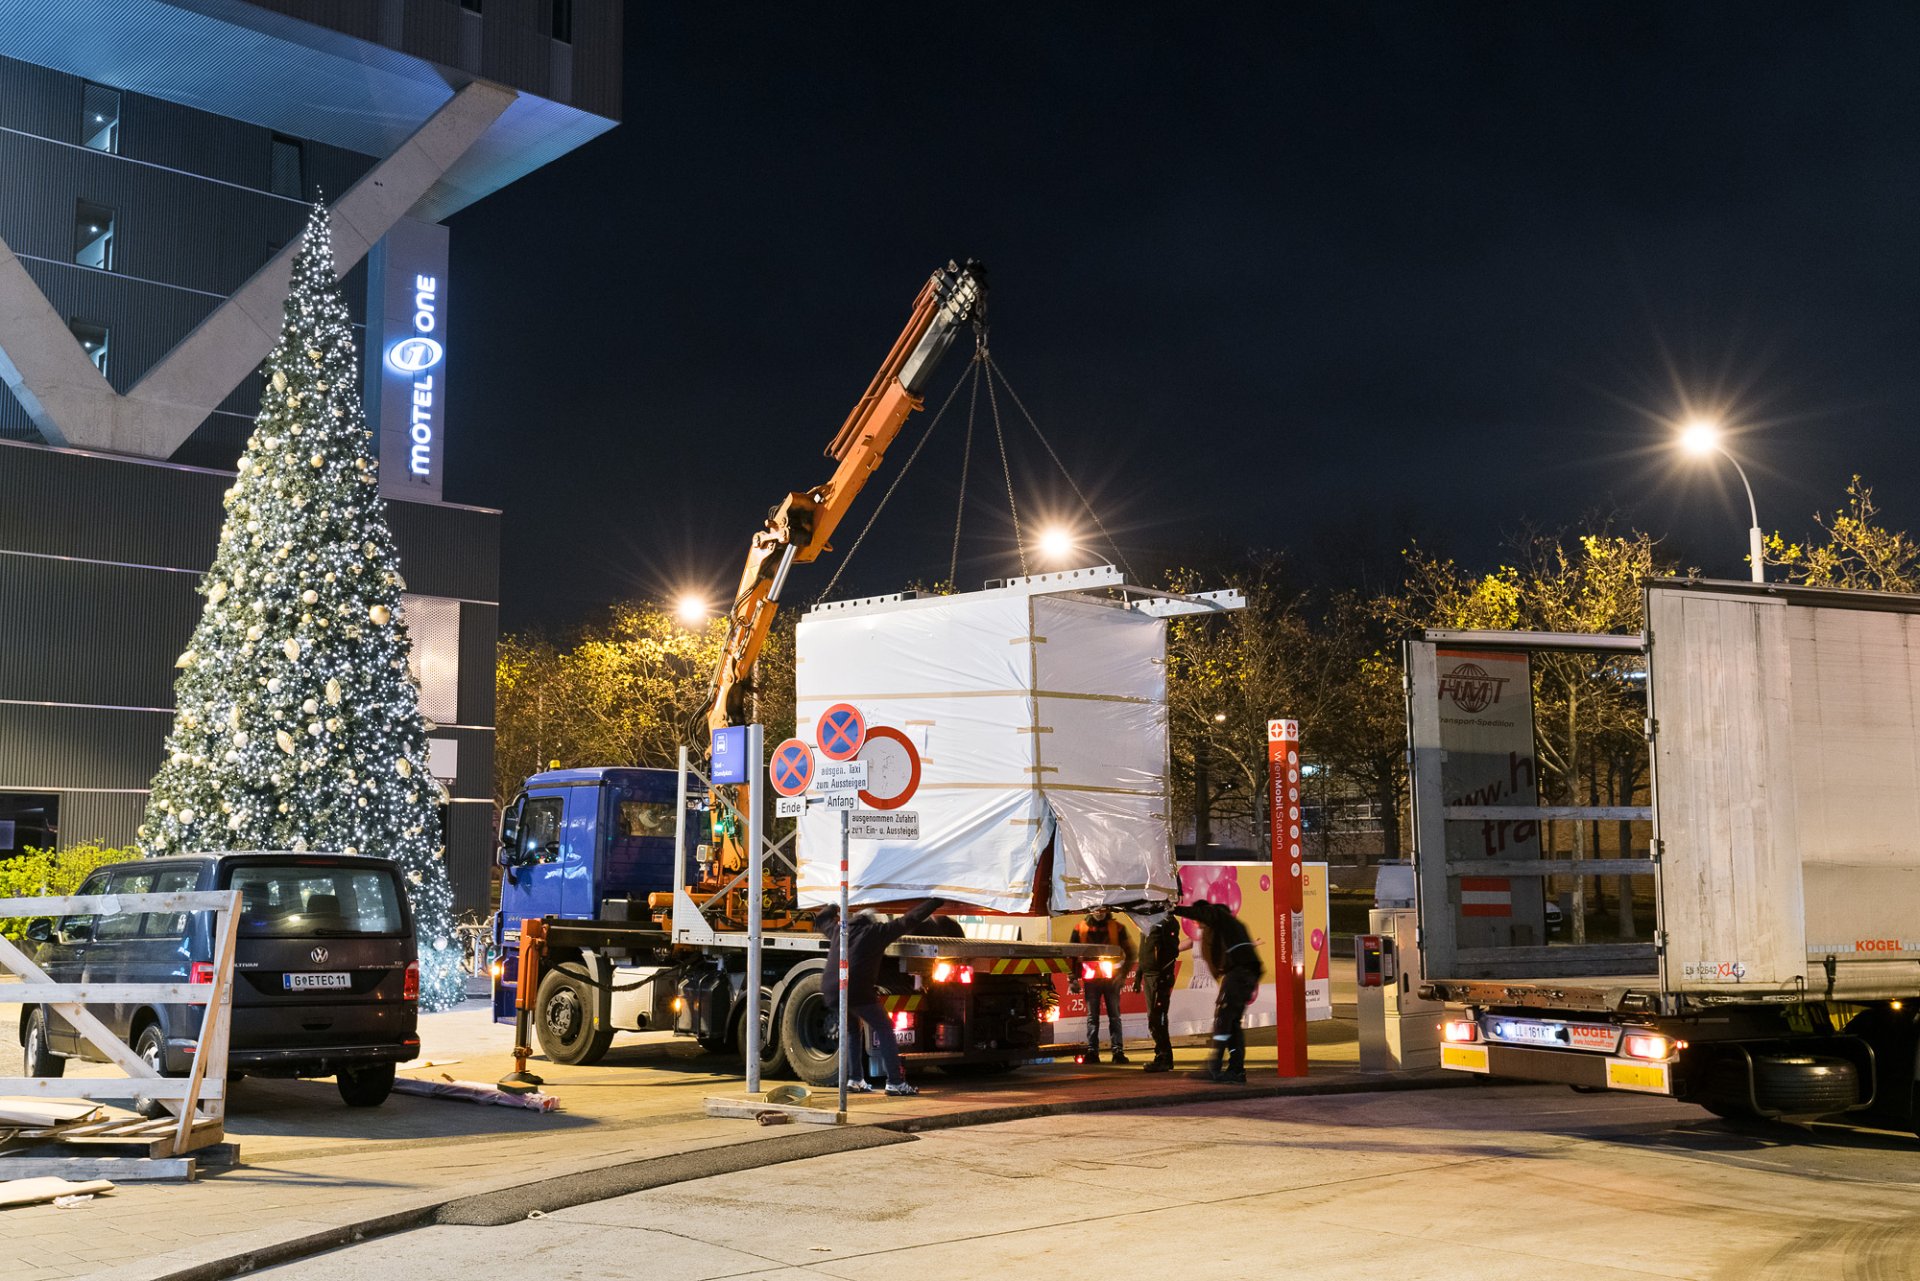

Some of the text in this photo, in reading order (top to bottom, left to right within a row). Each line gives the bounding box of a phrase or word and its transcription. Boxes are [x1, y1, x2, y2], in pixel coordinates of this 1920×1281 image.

[416, 274, 435, 332] ONE
[411, 375, 432, 475] MOTEL
[1438, 673, 1510, 704] HMT
[1440, 716, 1515, 728] ransport-Spedition
[849, 764, 861, 774] Taxi
[816, 778, 866, 792] zum Aussteigen
[781, 802, 801, 813] Ende
[827, 795, 854, 809] Anfang
[852, 813, 917, 825] ausgenommen Zufahrt
[887, 826, 917, 837] Aussteigen
[1855, 939, 1903, 951] KÖGEL
